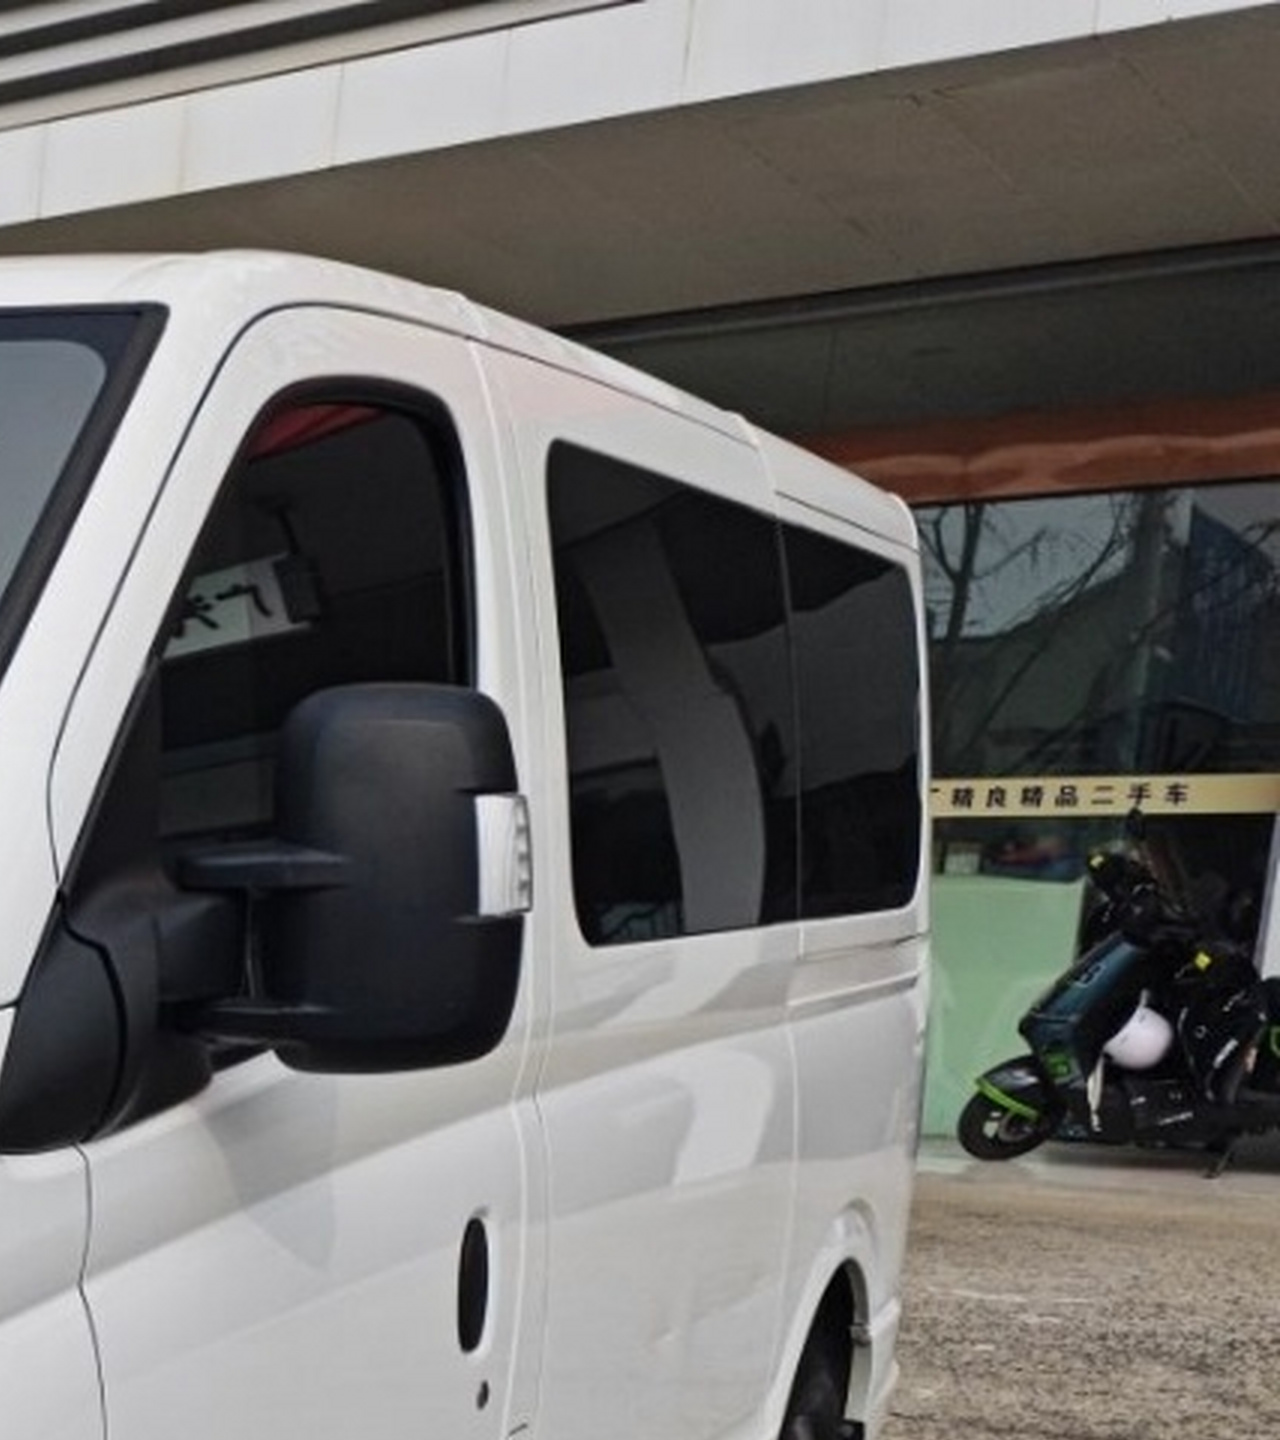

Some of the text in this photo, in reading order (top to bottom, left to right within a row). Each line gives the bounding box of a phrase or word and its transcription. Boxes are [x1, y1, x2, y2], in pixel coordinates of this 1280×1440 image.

[929, 782, 1189, 809] 精良精品二手车
